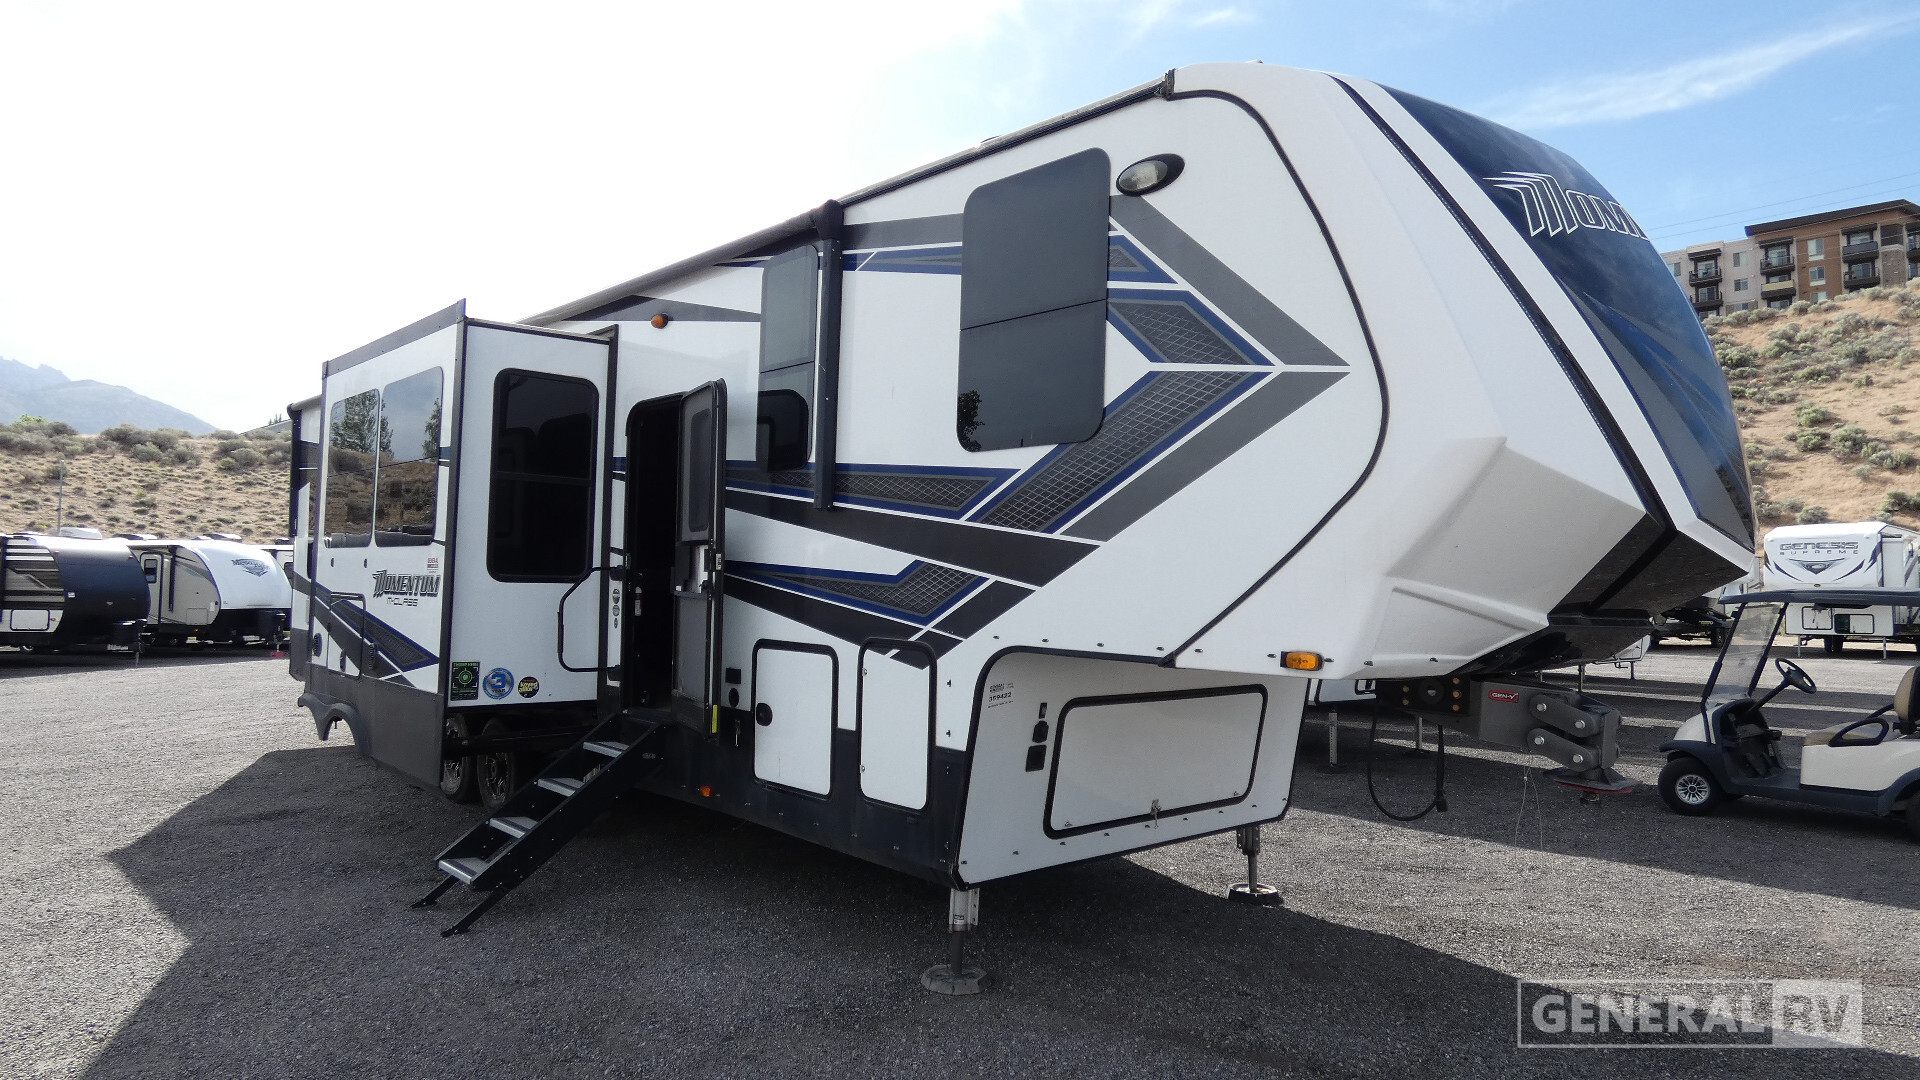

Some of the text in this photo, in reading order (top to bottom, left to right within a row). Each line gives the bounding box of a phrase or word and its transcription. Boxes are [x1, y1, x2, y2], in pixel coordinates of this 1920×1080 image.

[1482, 171, 1650, 240] MOM
[1779, 541, 1859, 551] GENESIS
[372, 569, 441, 598] MOMENTUM
[387, 597, 419, 607] M-CLASS
[491, 673, 507, 689] 3
